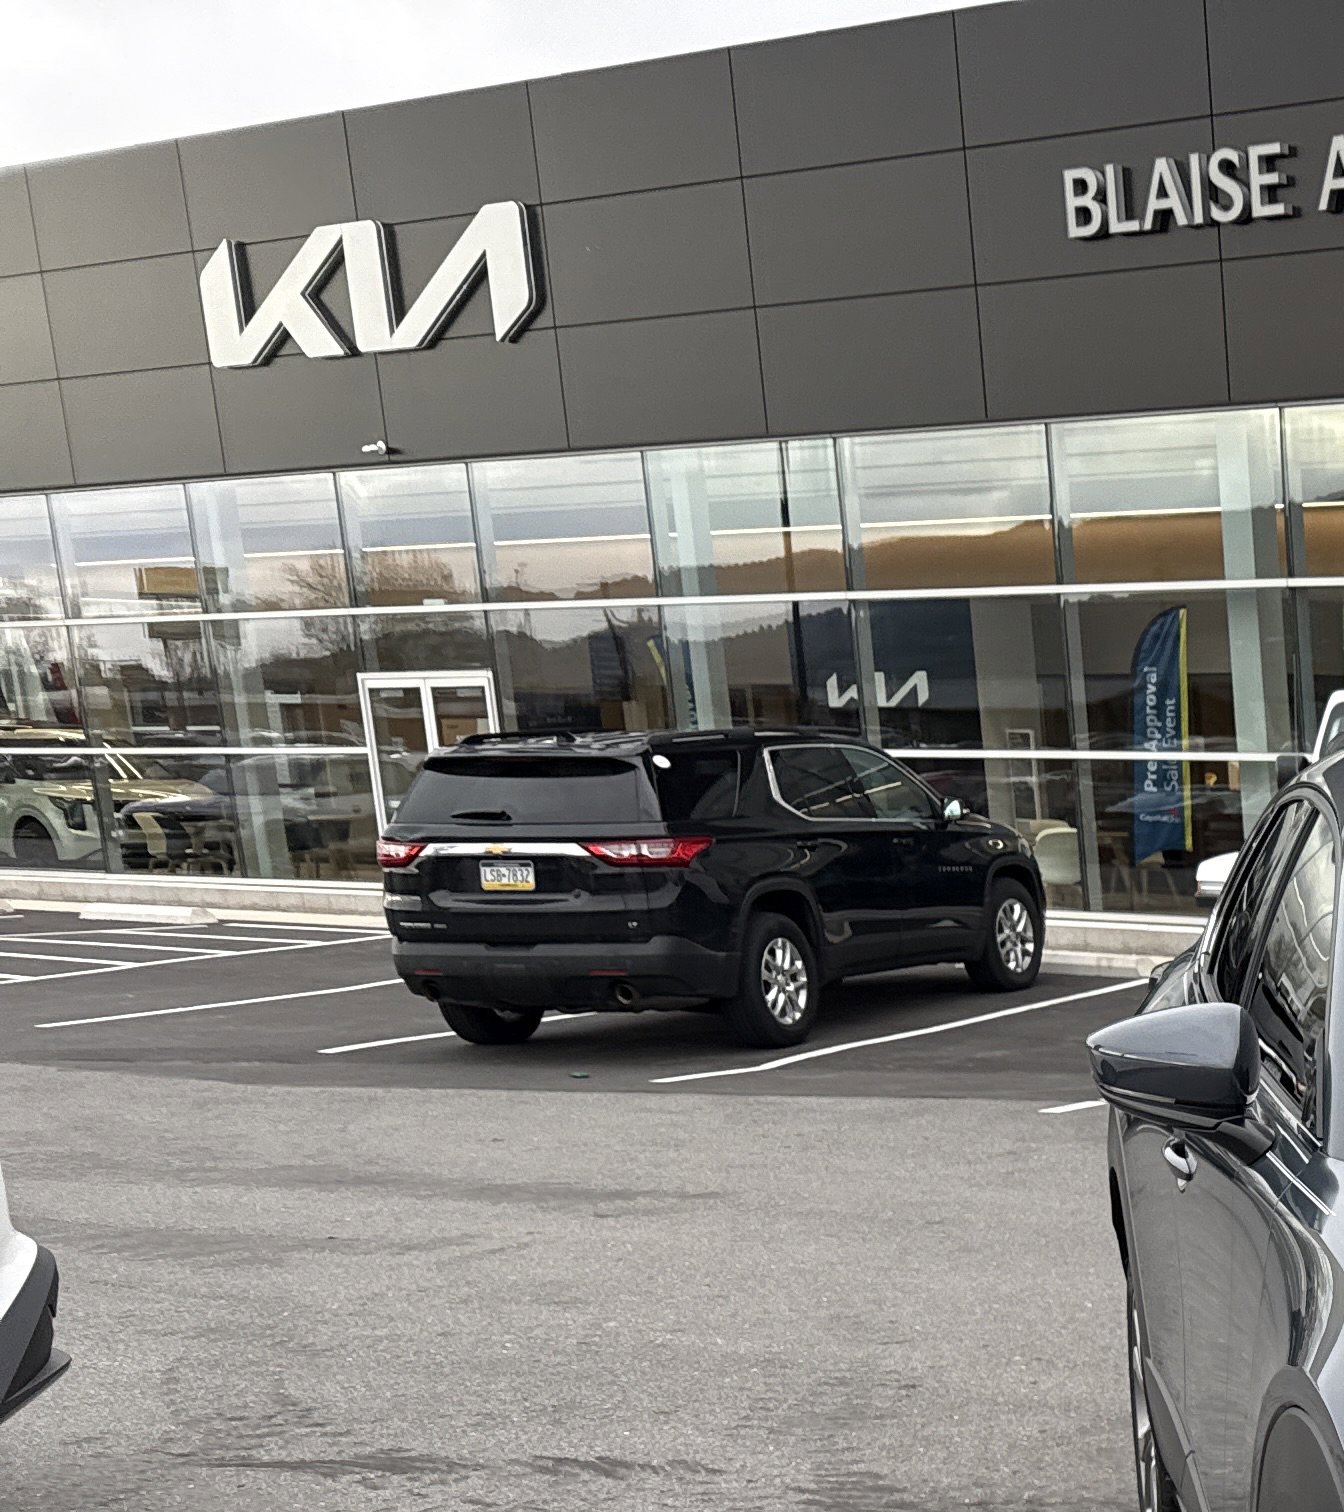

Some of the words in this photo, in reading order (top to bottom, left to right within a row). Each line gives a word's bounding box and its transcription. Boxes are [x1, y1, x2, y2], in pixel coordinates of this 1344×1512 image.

[1062, 141, 1295, 239] BLAISE
[199, 199, 536, 368] KIA
[1161, 697, 1178, 748] Event
